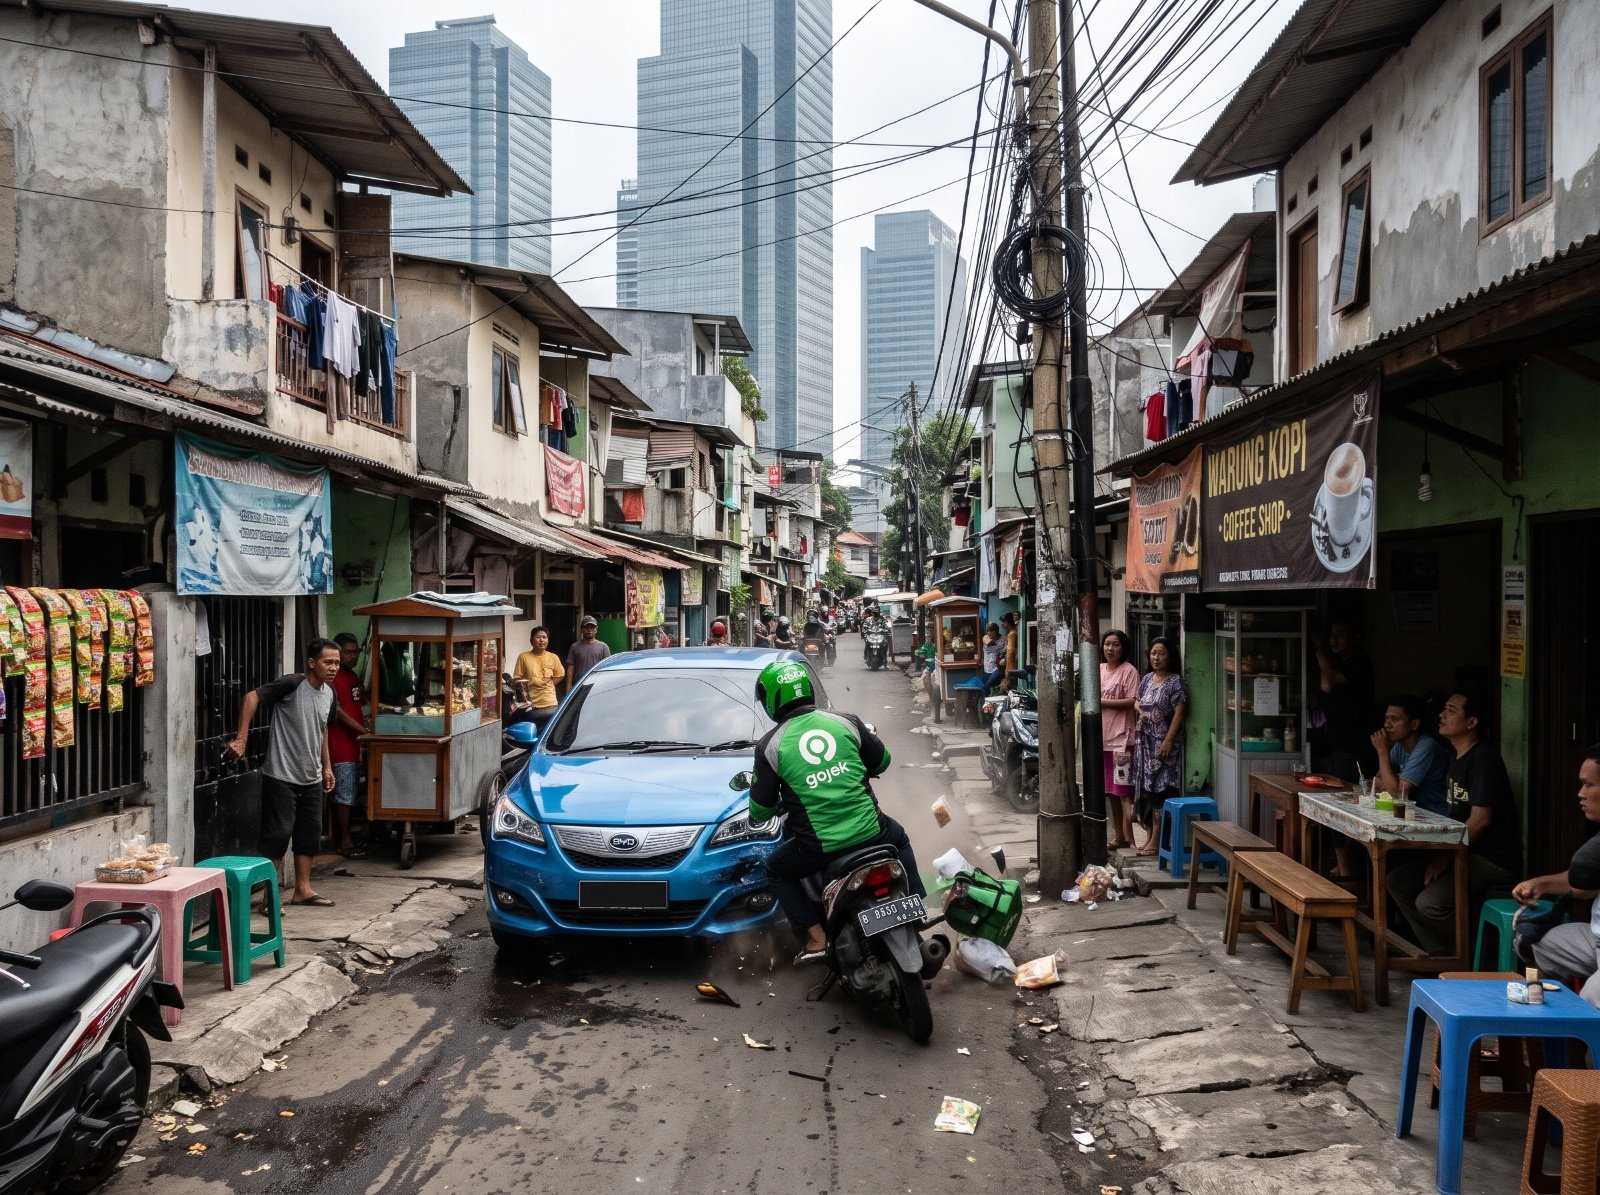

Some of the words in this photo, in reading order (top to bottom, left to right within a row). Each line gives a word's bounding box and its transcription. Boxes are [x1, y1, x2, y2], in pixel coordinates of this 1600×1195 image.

[1208, 434, 1264, 498] WARUNG
[1268, 418, 1307, 481] KOPI
[1223, 506, 1257, 542] COFFEE
[1258, 500, 1285, 537] SHOP
[806, 761, 850, 789] gojek
[612, 838, 635, 846] BYD
